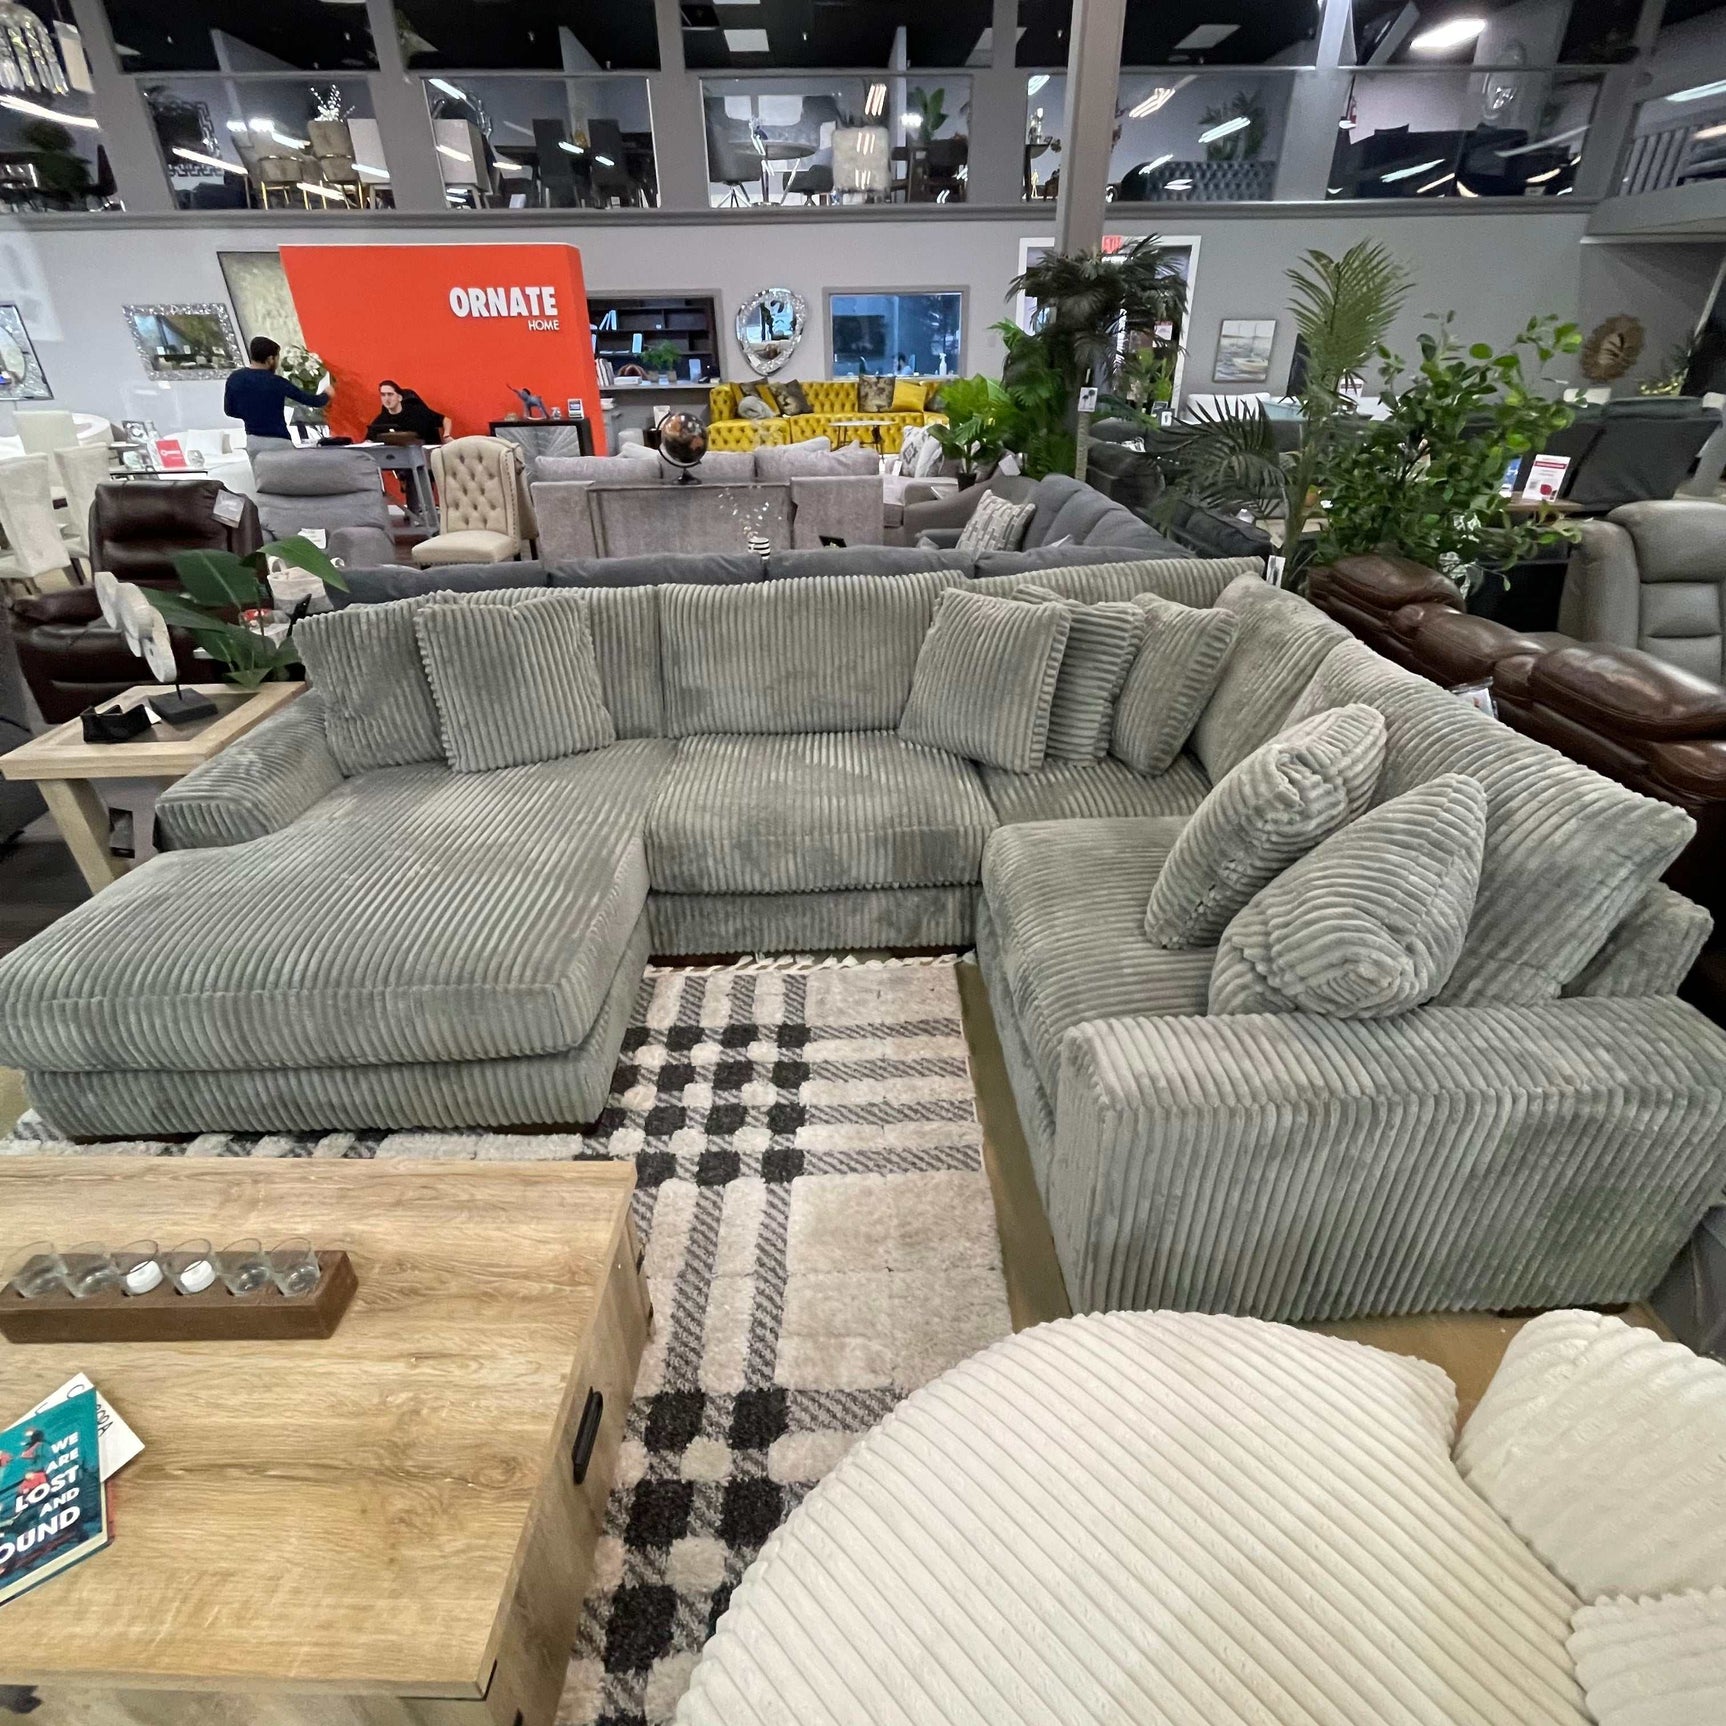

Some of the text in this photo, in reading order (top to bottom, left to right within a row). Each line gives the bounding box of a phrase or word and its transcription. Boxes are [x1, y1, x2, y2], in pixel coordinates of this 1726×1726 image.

[449, 286, 558, 317] ORNATE
[528, 319, 560, 331] HOME
[51, 1431, 79, 1454] WE
[45, 1447, 79, 1474] ARE
[15, 1464, 80, 1513] LOST
[39, 1487, 80, 1518] AND
[0, 1505, 81, 1564] OUND
